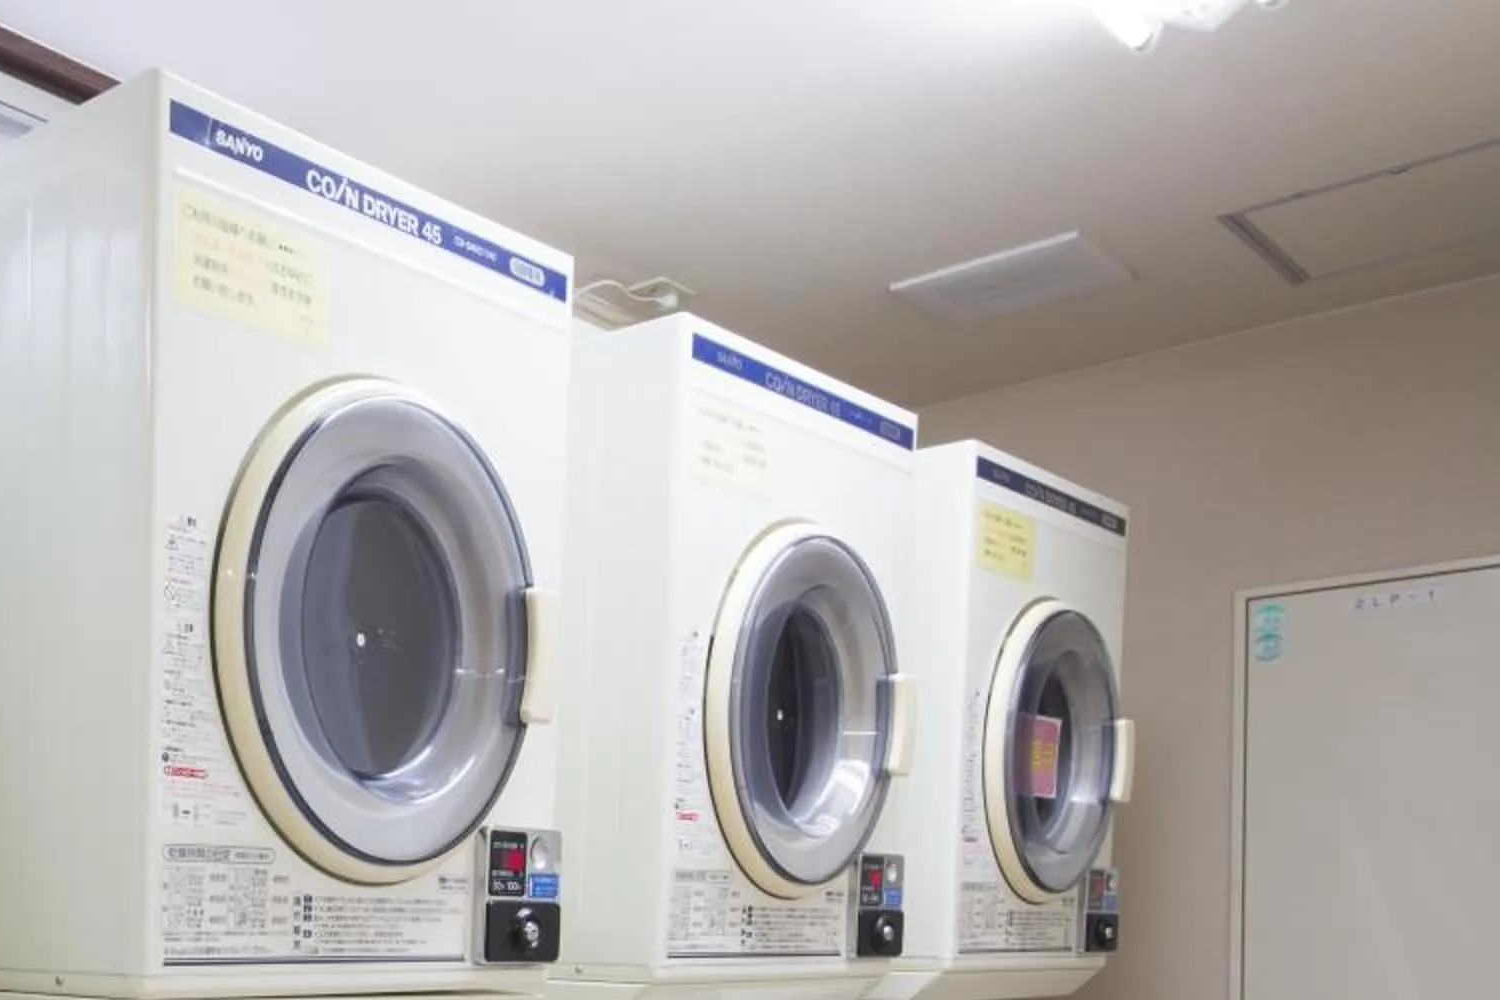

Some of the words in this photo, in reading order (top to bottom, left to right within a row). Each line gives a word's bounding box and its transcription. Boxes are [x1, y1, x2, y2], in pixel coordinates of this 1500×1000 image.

[216, 129, 263, 162] SANYO
[363, 194, 419, 236] DRYER
[421, 221, 442, 244] 45
